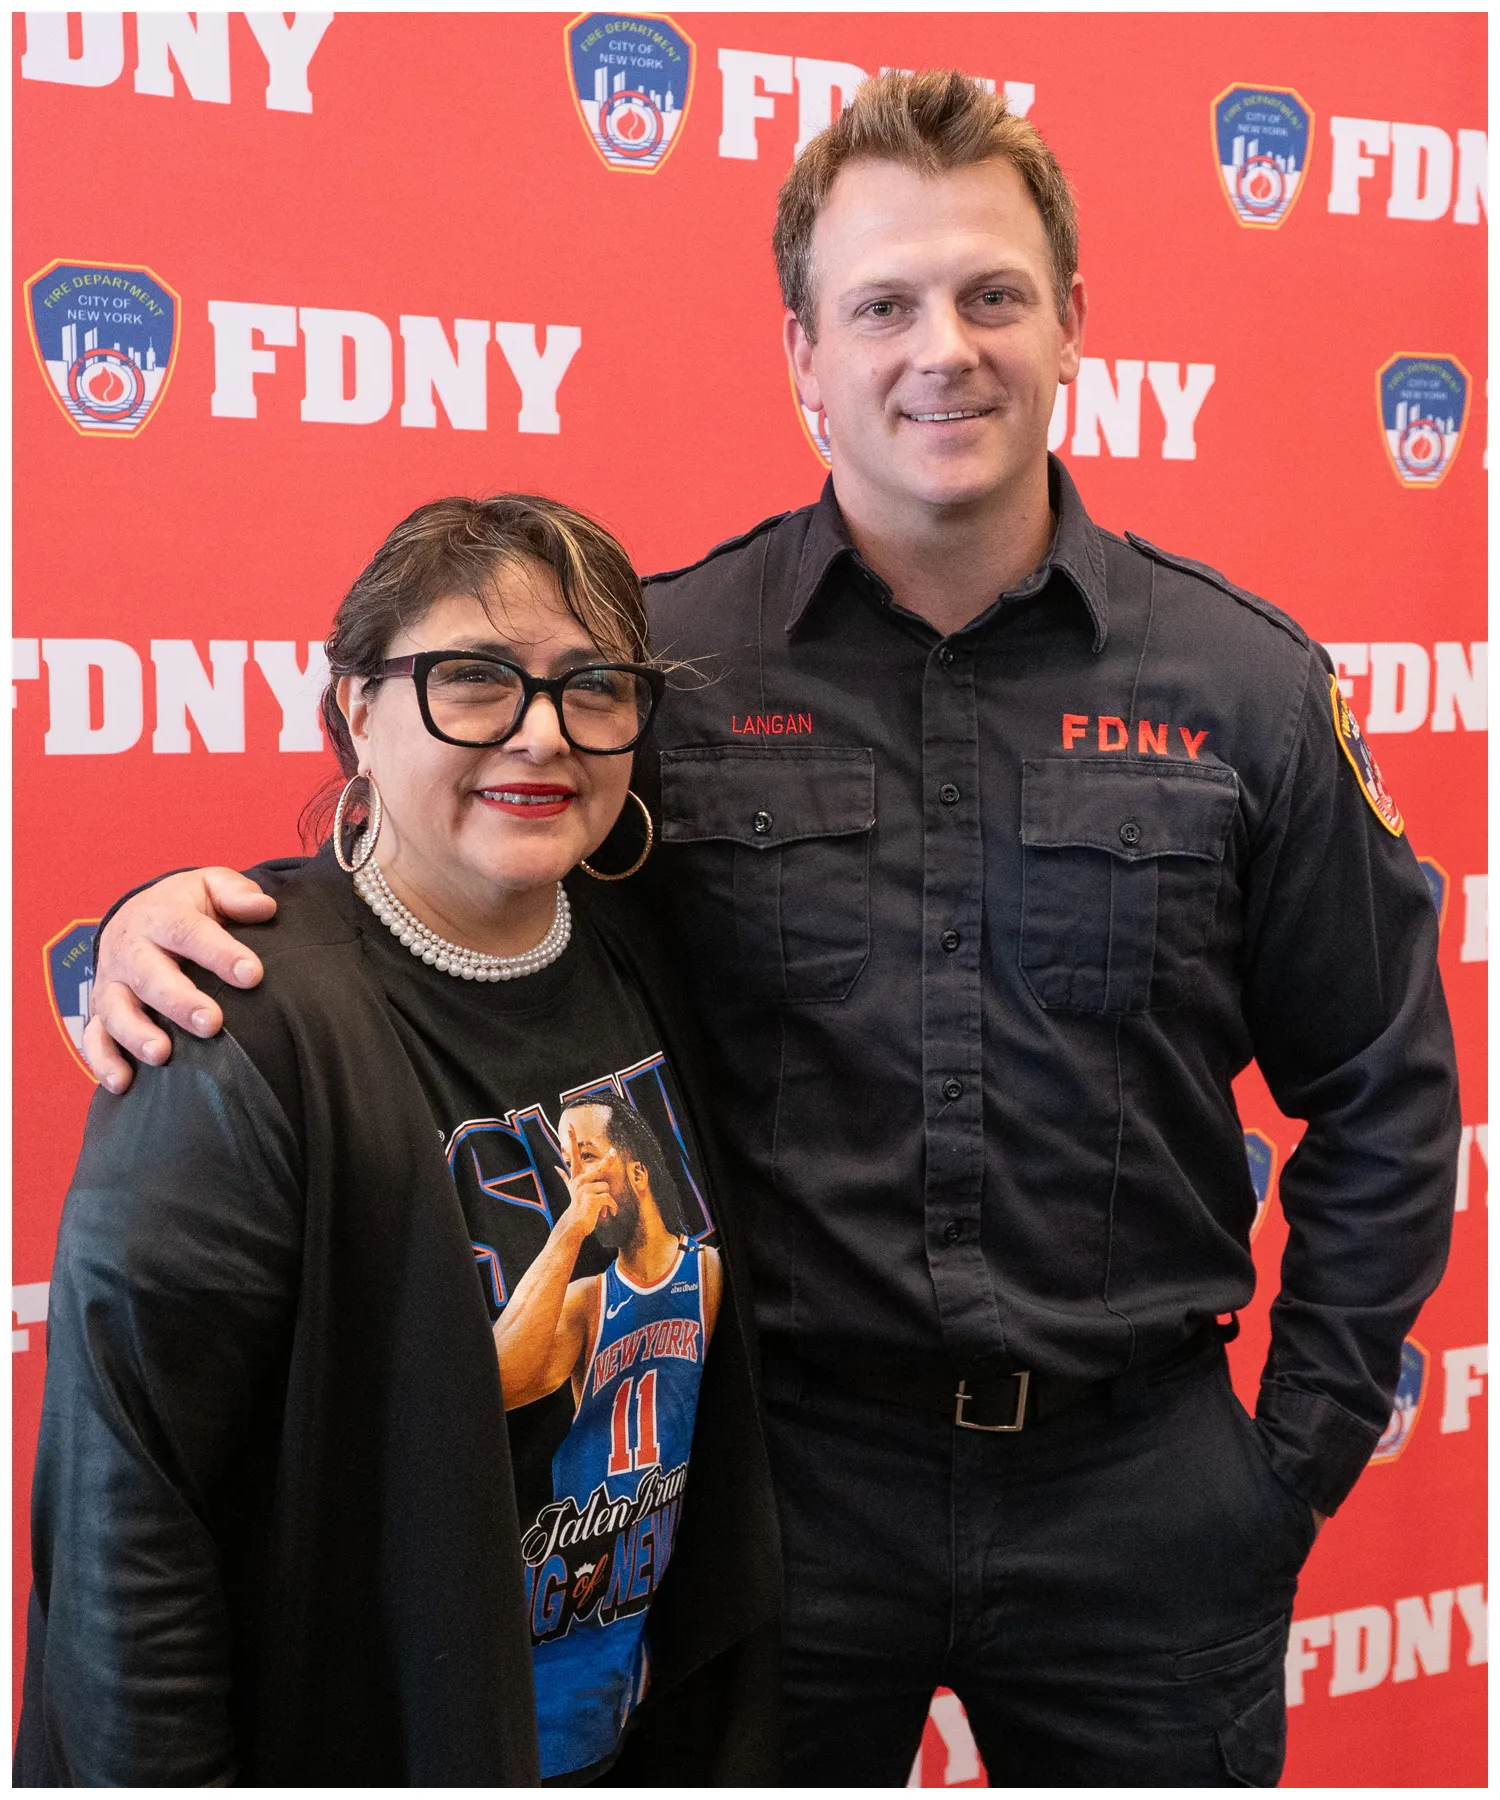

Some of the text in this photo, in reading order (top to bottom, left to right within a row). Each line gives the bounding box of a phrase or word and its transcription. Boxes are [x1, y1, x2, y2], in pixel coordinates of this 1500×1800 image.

[580, 21, 681, 62] FIRE DEPARTMENT
[599, 53, 663, 69] NEW YORK
[608, 40, 654, 54] CITY OF
[44, 274, 164, 318] FIRE DEPARTMENT
[67, 309, 143, 325] NEW YORK
[78, 294, 131, 309] CITY OF
[208, 300, 582, 435] FDNY
[731, 713, 813, 735] LANGAN
[1061, 713, 1209, 760] FDNY
[62, 940, 87, 969] FIRE
[592, 1318, 701, 1398] NEW YORK
[607, 1368, 660, 1477] 11
[522, 1492, 633, 1568] Jalen
[573, 1552, 609, 1610] of
